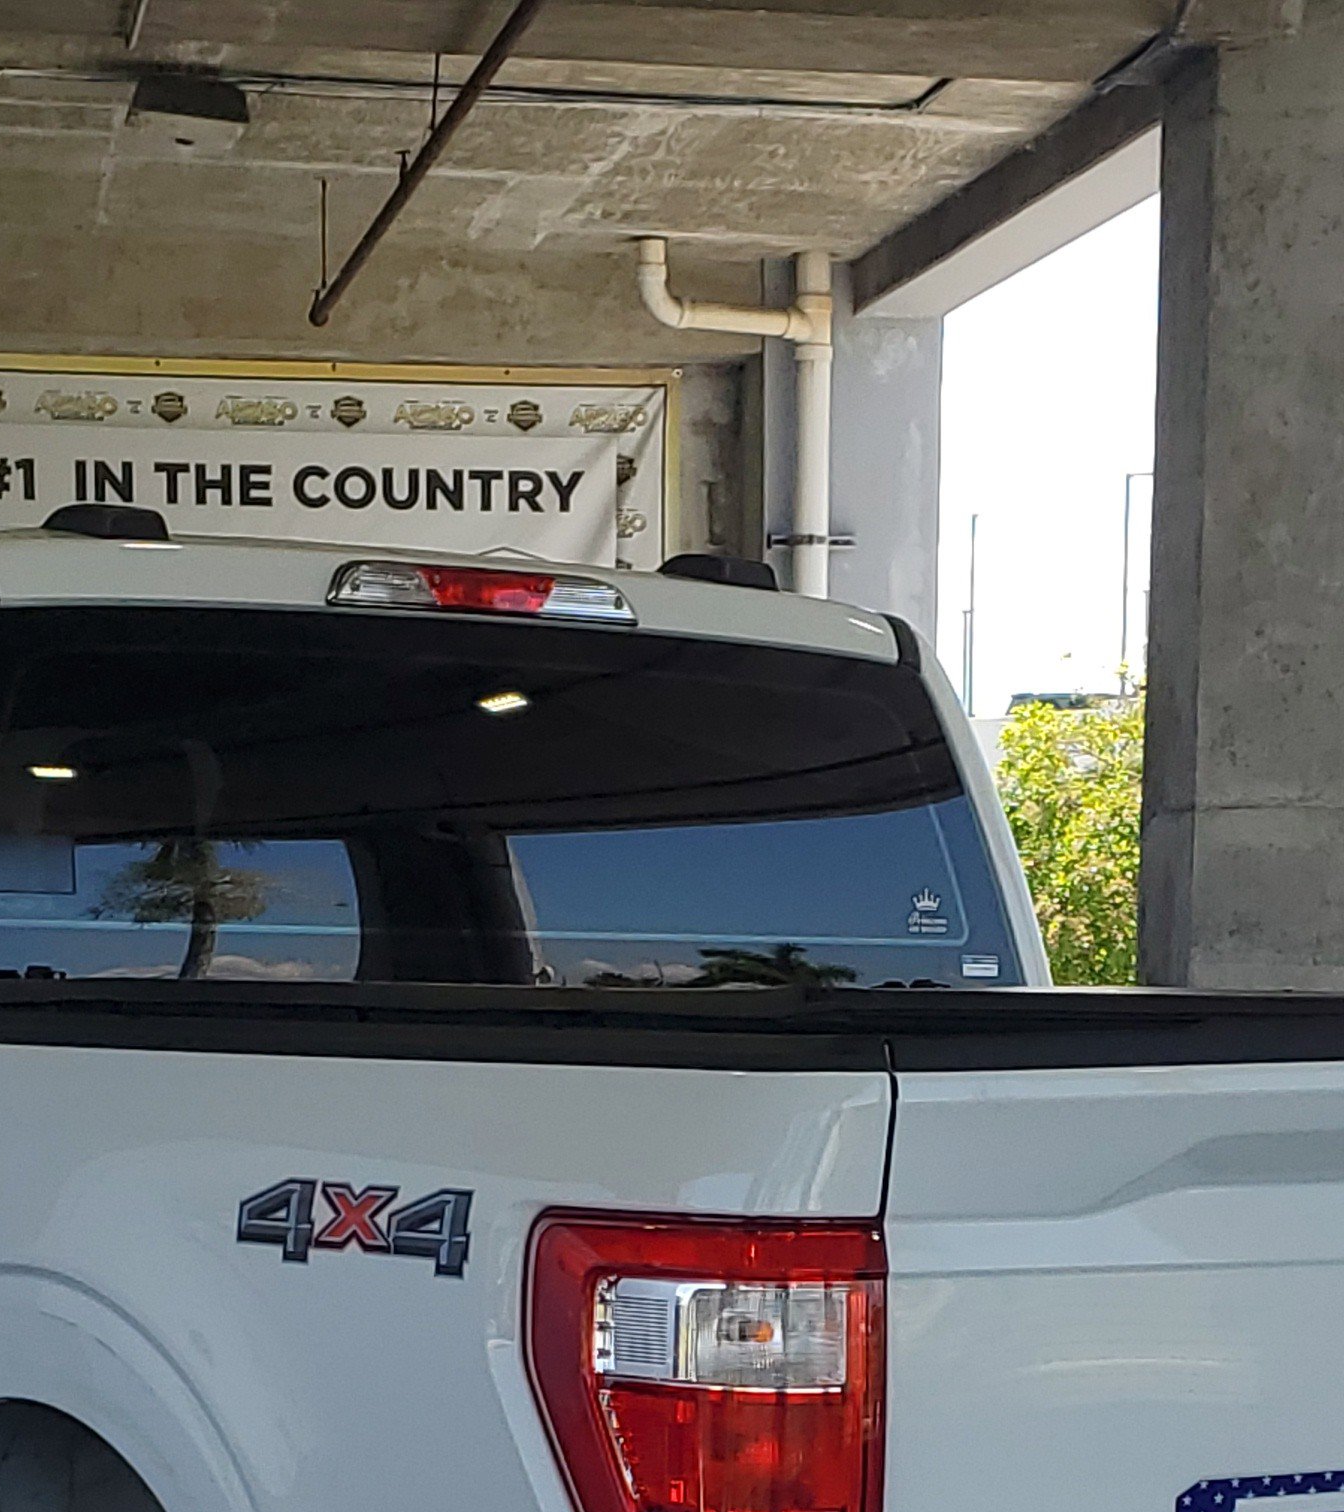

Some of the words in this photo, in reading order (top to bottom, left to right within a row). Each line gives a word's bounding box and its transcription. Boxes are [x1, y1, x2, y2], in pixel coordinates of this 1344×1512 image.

[75, 460, 134, 503] IN
[154, 462, 273, 507] THE
[293, 466, 585, 513] COUNTRY
